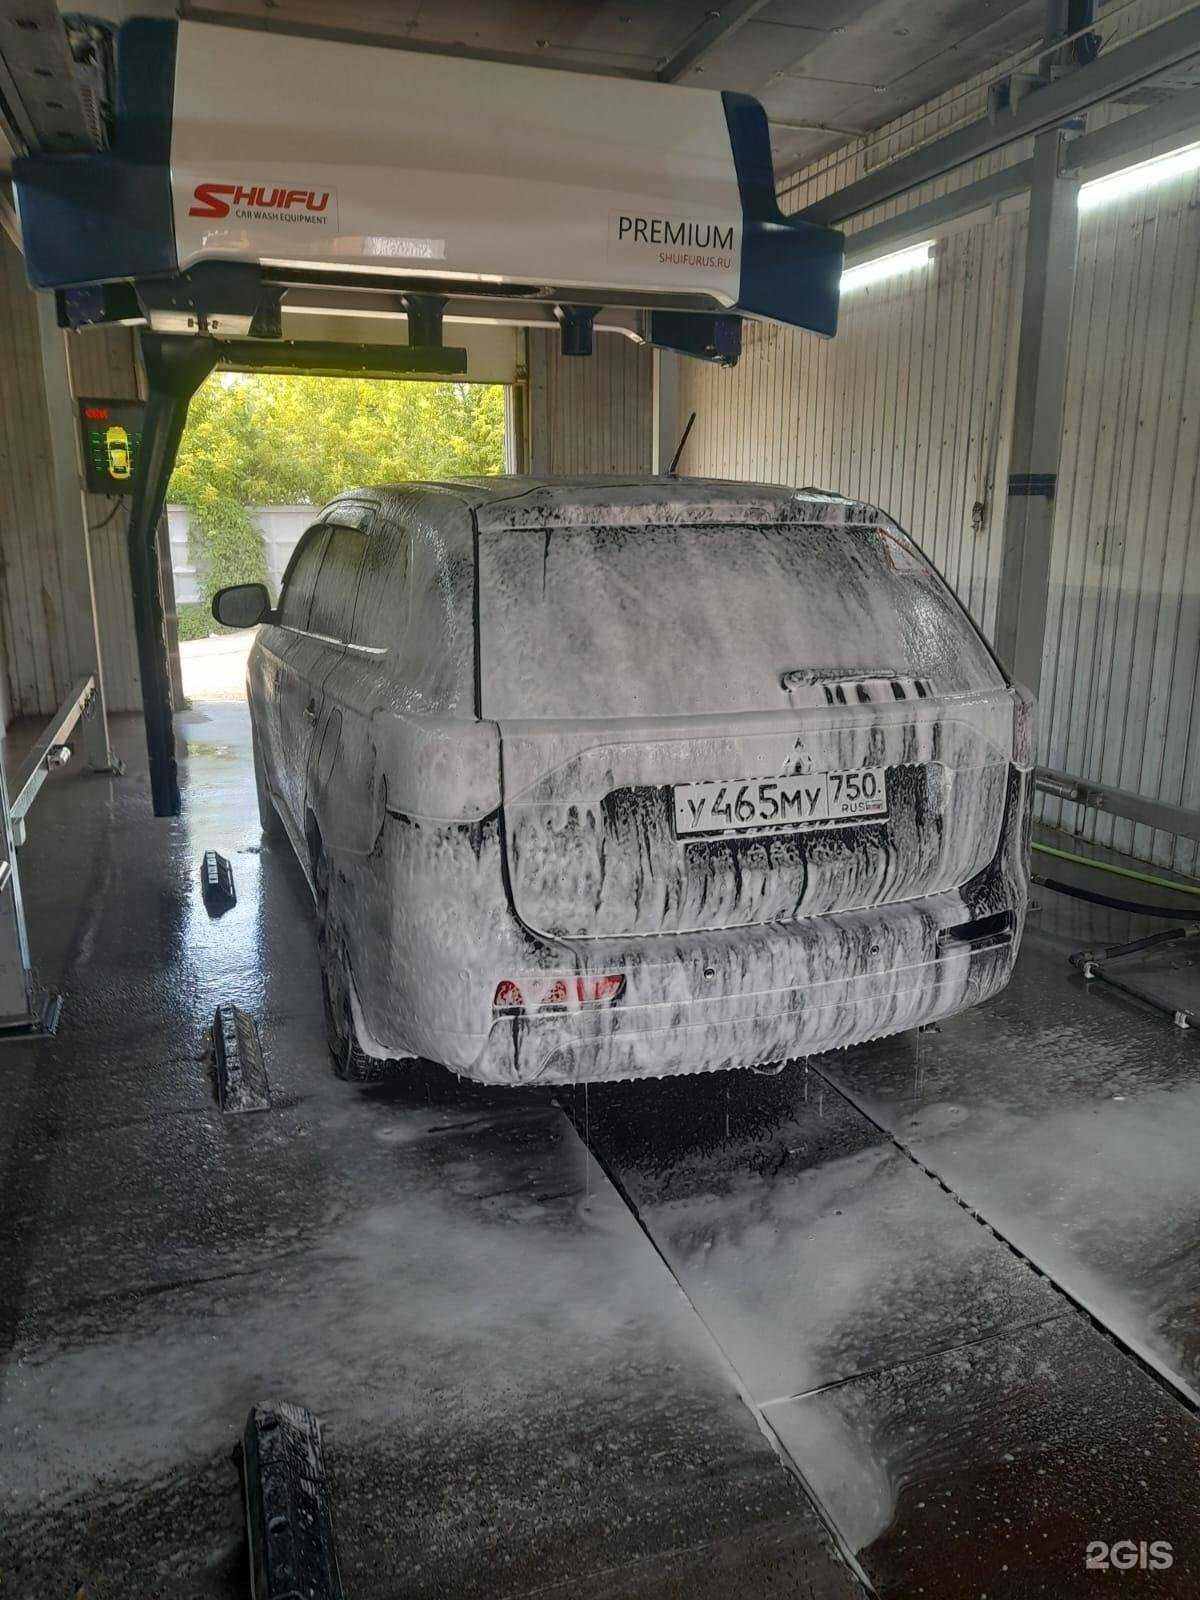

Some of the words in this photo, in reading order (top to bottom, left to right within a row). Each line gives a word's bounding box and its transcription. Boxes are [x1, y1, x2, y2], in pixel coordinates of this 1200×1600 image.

[189, 183, 329, 218] SHUIFU
[235, 209, 252, 219] CAR
[254, 210, 278, 221] WASH
[280, 212, 327, 225] EQUIPMENT
[618, 216, 734, 250] PREMIUM
[659, 252, 731, 269] SHUIFURUS.RU
[829, 772, 876, 803] 750
[841, 802, 865, 813] RUS
